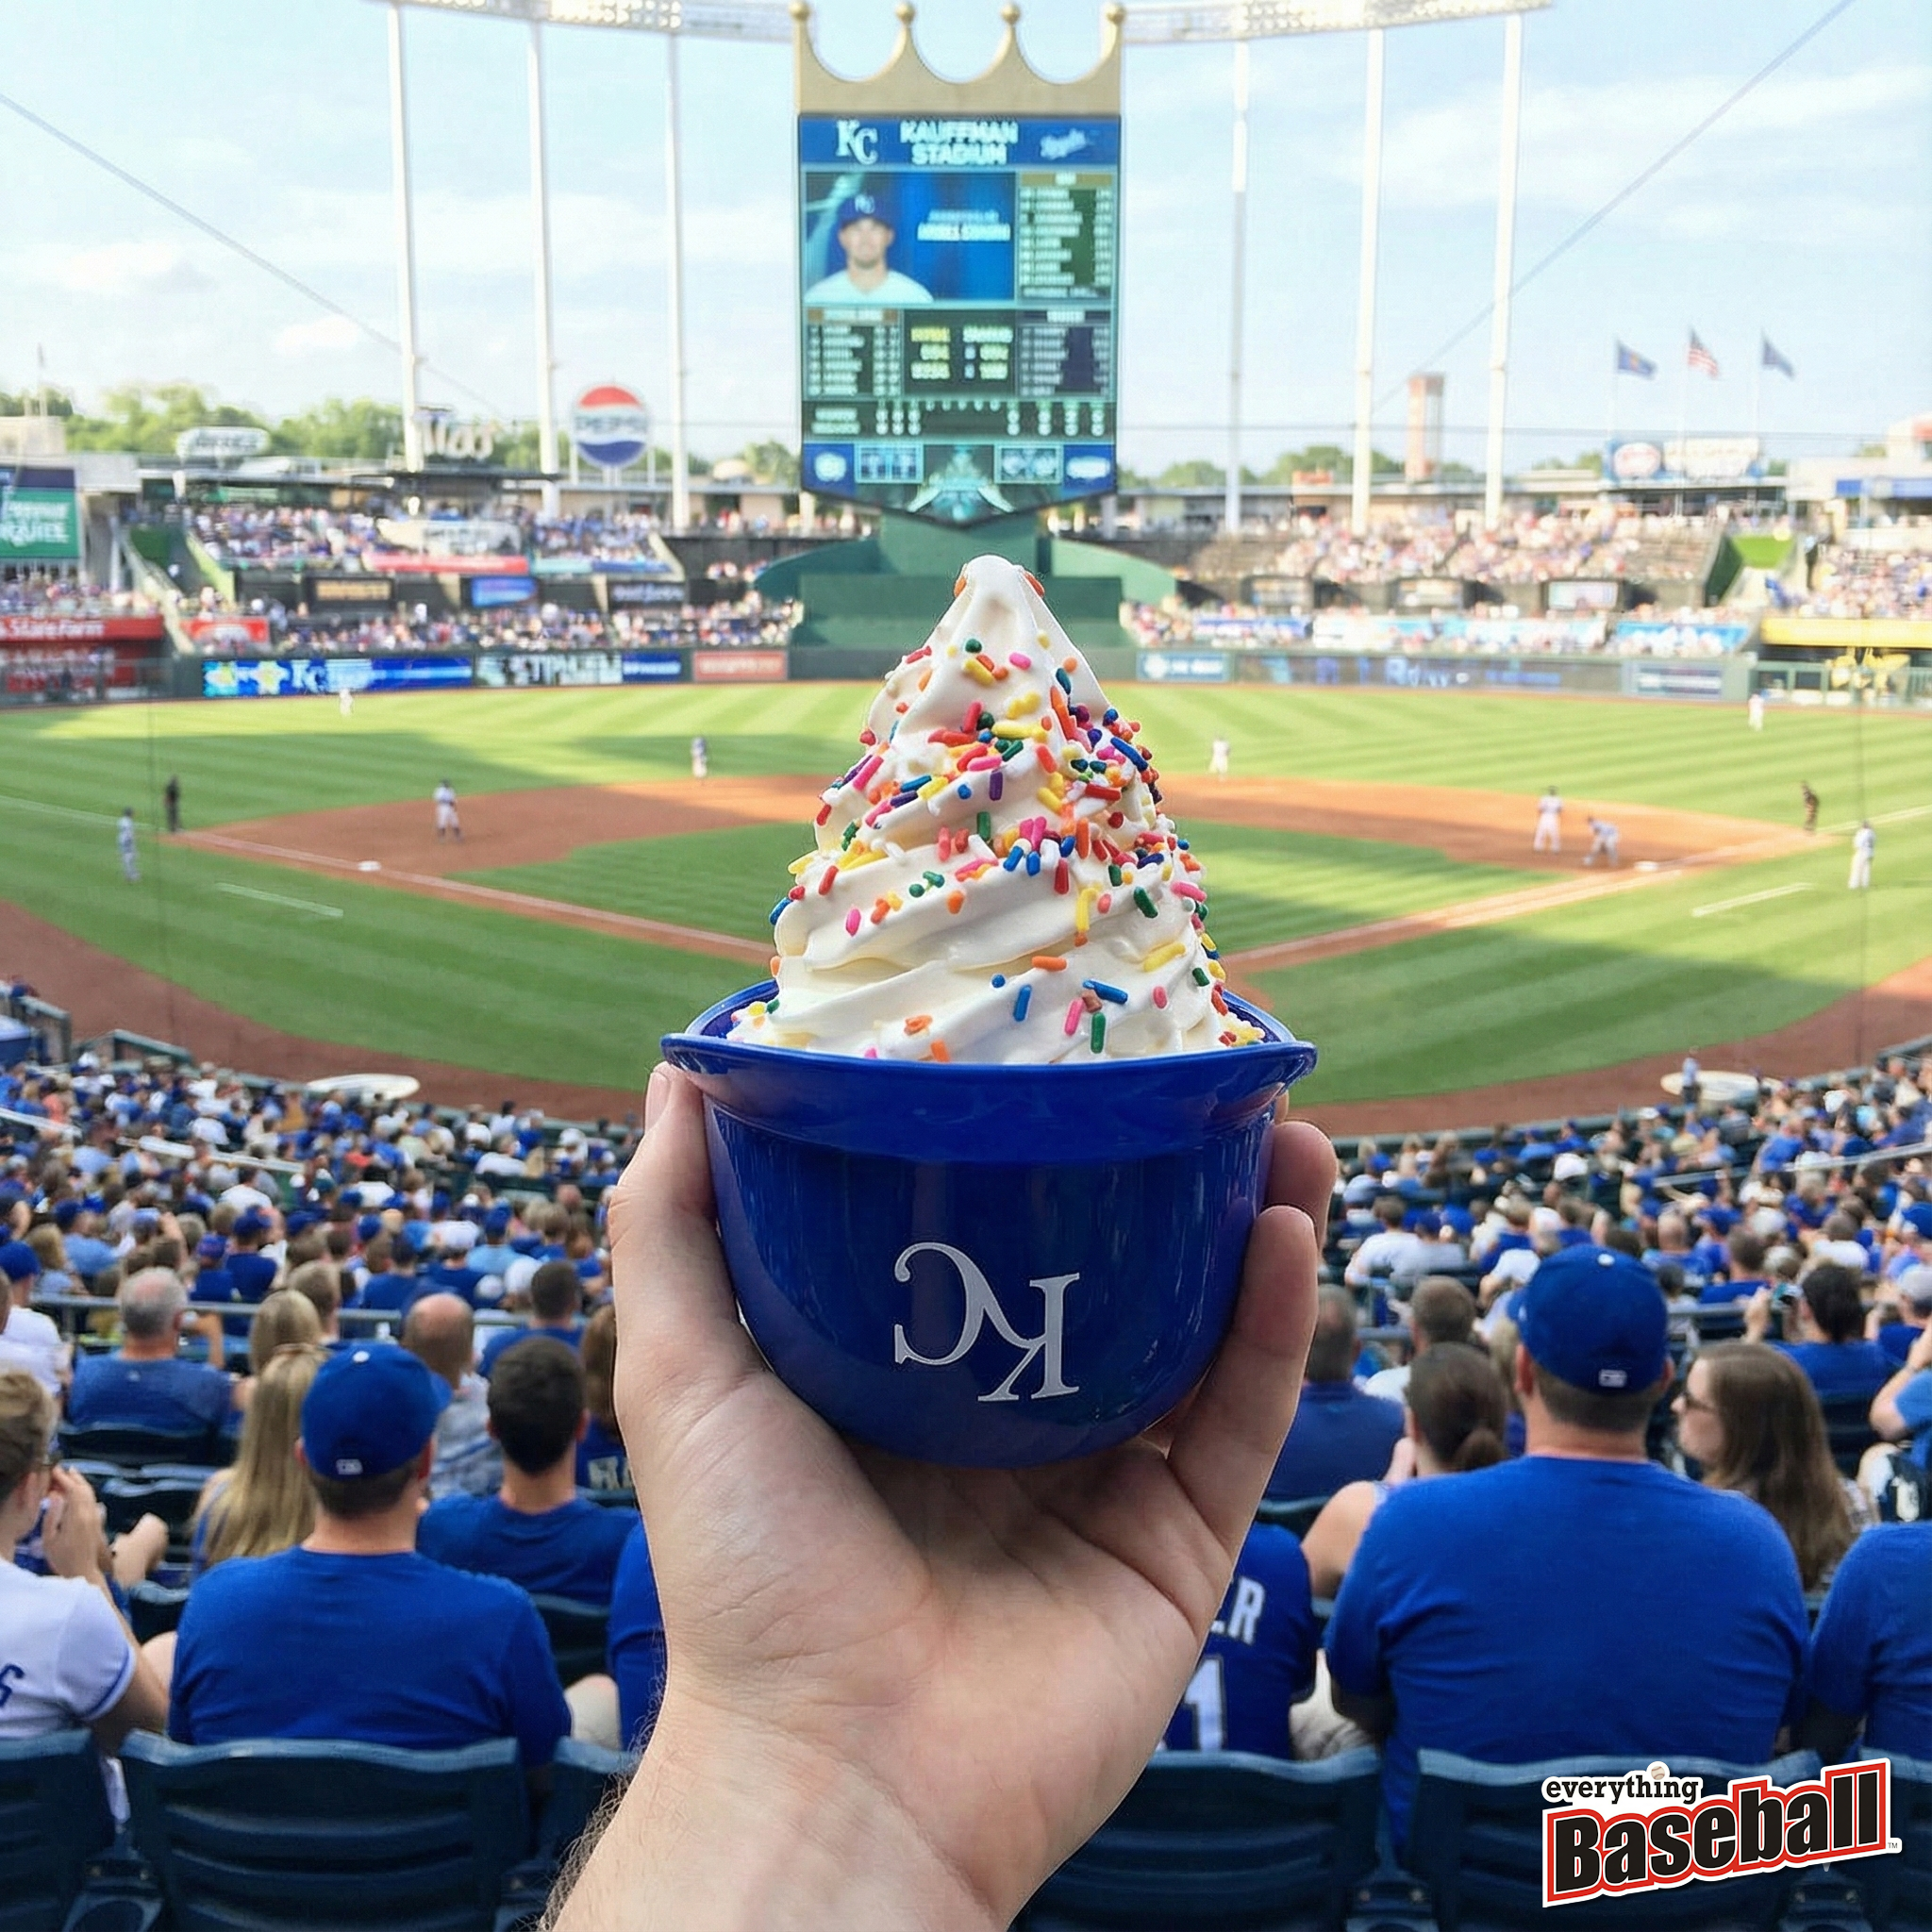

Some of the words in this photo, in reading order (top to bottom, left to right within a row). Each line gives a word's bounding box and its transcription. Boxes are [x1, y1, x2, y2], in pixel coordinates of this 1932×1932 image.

[836, 120, 878, 165] KC
[900, 120, 1018, 142] KAUFFMAN
[911, 143, 1007, 165] STADIUM
[894, 1242, 1079, 1402] KC
